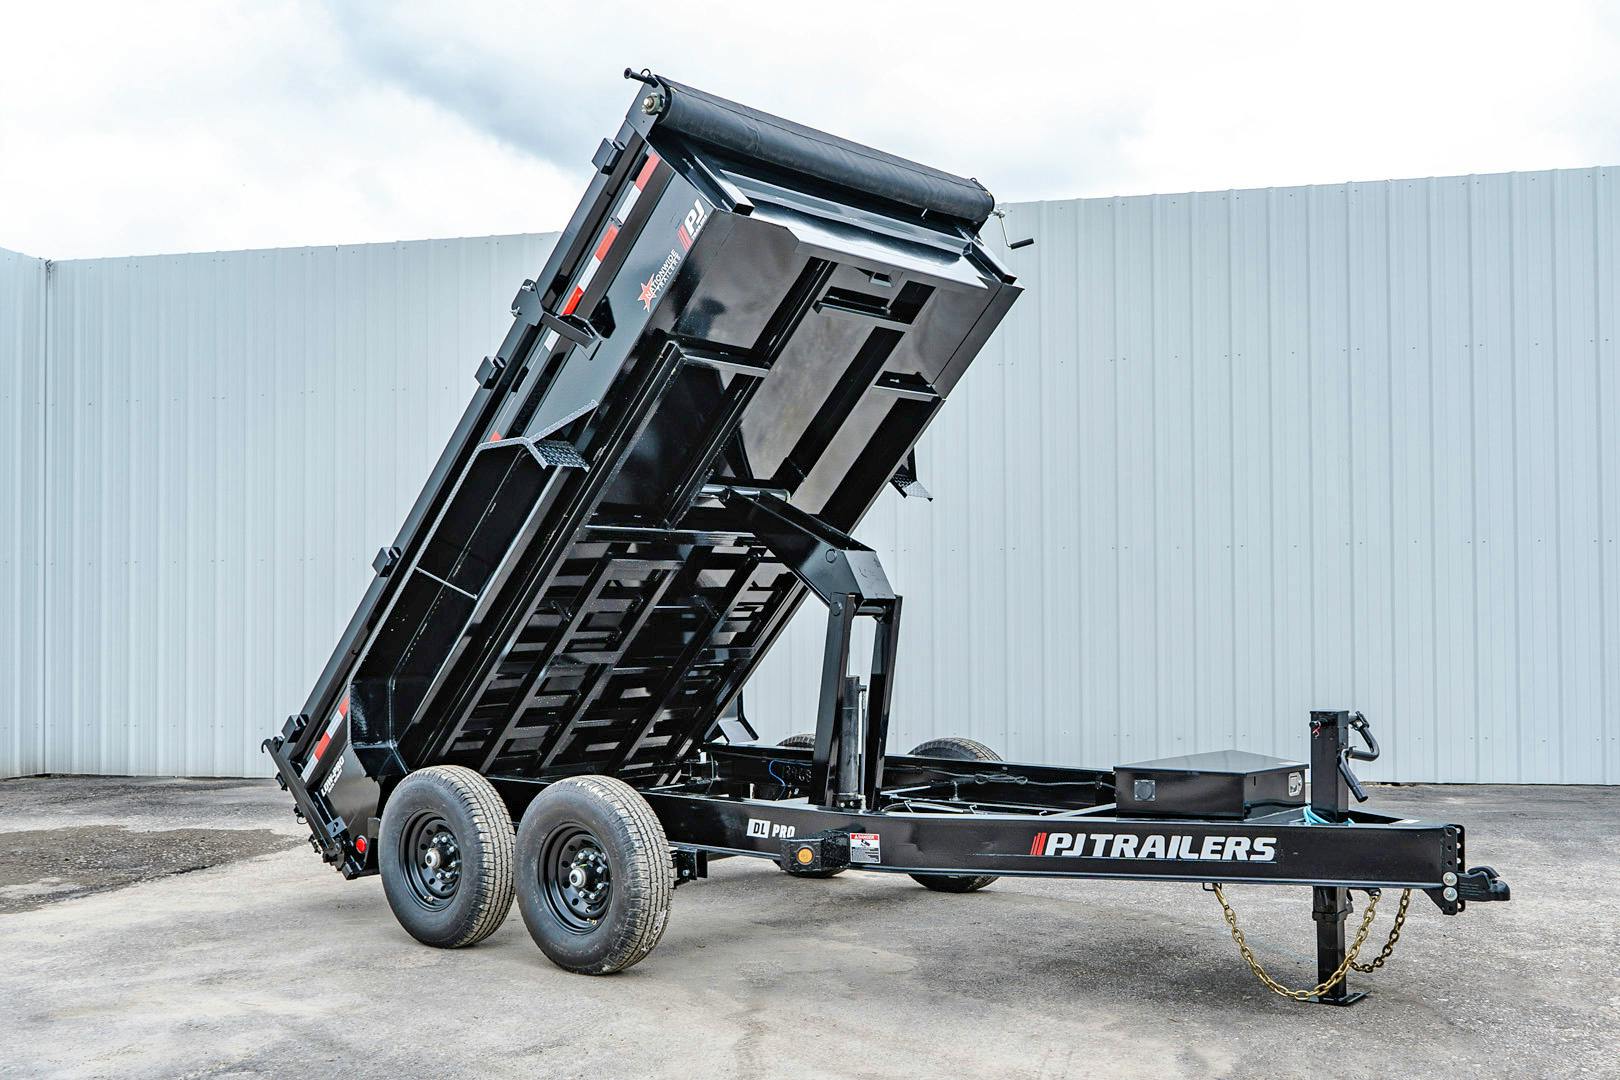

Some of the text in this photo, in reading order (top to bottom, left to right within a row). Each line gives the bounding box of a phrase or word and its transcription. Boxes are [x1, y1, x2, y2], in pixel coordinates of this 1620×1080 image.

[684, 199, 705, 237] PJ
[644, 248, 679, 299] NATIONWIDE
[657, 254, 681, 291] TRAILERS
[752, 822, 796, 838] DL PRO
[1045, 832, 1277, 861] PJ TRAILERS
